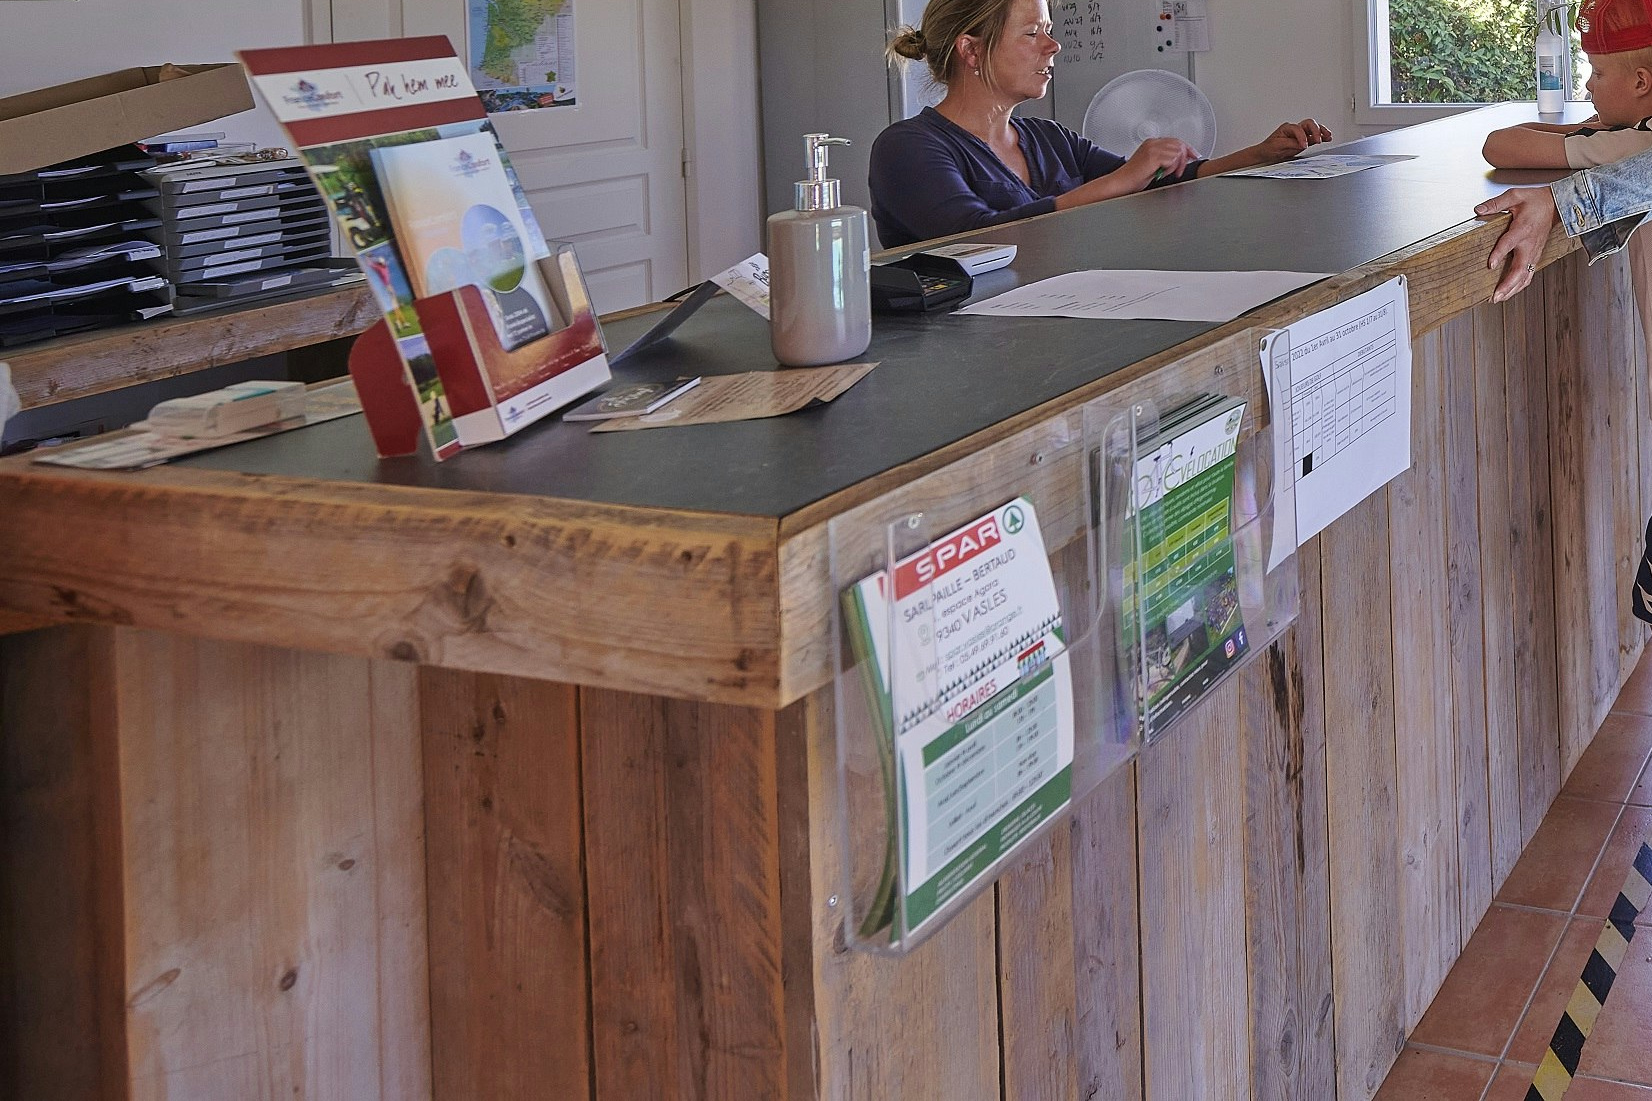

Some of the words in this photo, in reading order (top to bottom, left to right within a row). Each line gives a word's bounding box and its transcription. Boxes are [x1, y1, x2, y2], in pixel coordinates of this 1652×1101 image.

[1292, 348, 1303, 361] 2022
[1304, 346, 1310, 354] du
[1311, 342, 1319, 351] 1er
[1319, 338, 1330, 349] Avril
[1336, 330, 1342, 340] 31
[1342, 324, 1359, 337] octobre
[916, 521, 999, 583] SPAR
[904, 599, 934, 622] SARL
[973, 549, 1016, 582] BERTAUD
[941, 595, 972, 618] espace
[974, 579, 1000, 598] Agora
[961, 588, 1008, 624] VASLES
[946, 678, 997, 722] HORAIRES
[993, 688, 1019, 712] samedi
